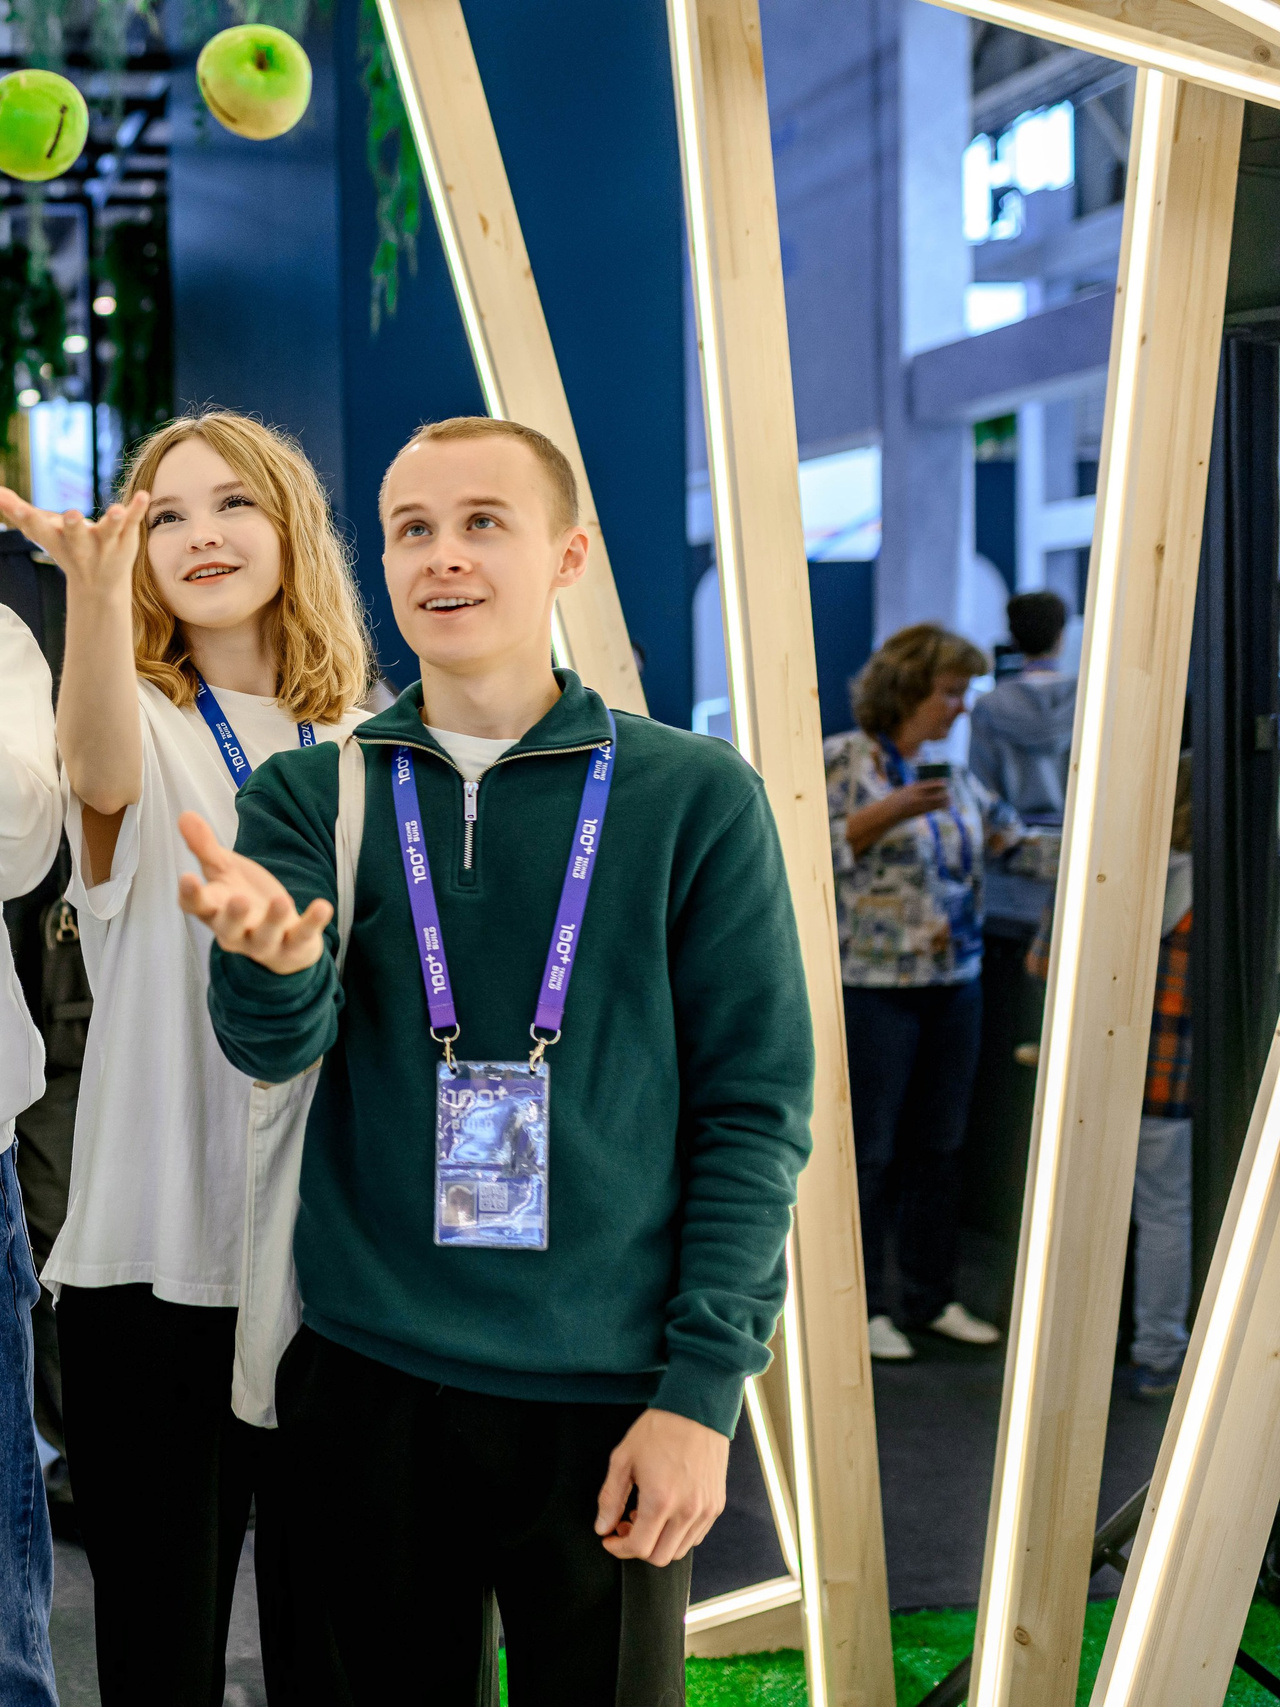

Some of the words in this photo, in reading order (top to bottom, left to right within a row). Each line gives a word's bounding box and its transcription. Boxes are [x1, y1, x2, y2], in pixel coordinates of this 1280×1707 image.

[223, 741, 246, 772] 100+
[395, 755, 411, 785] 100+
[410, 820, 420, 842] BUILD
[580, 818, 598, 855] 100+
[406, 845, 427, 884] 100+
[572, 855, 583, 879] BUILD
[428, 926, 440, 950] BUILD
[556, 923, 576, 965] 100+
[425, 953, 447, 995] 100+
[548, 964, 559, 989] BUILD
